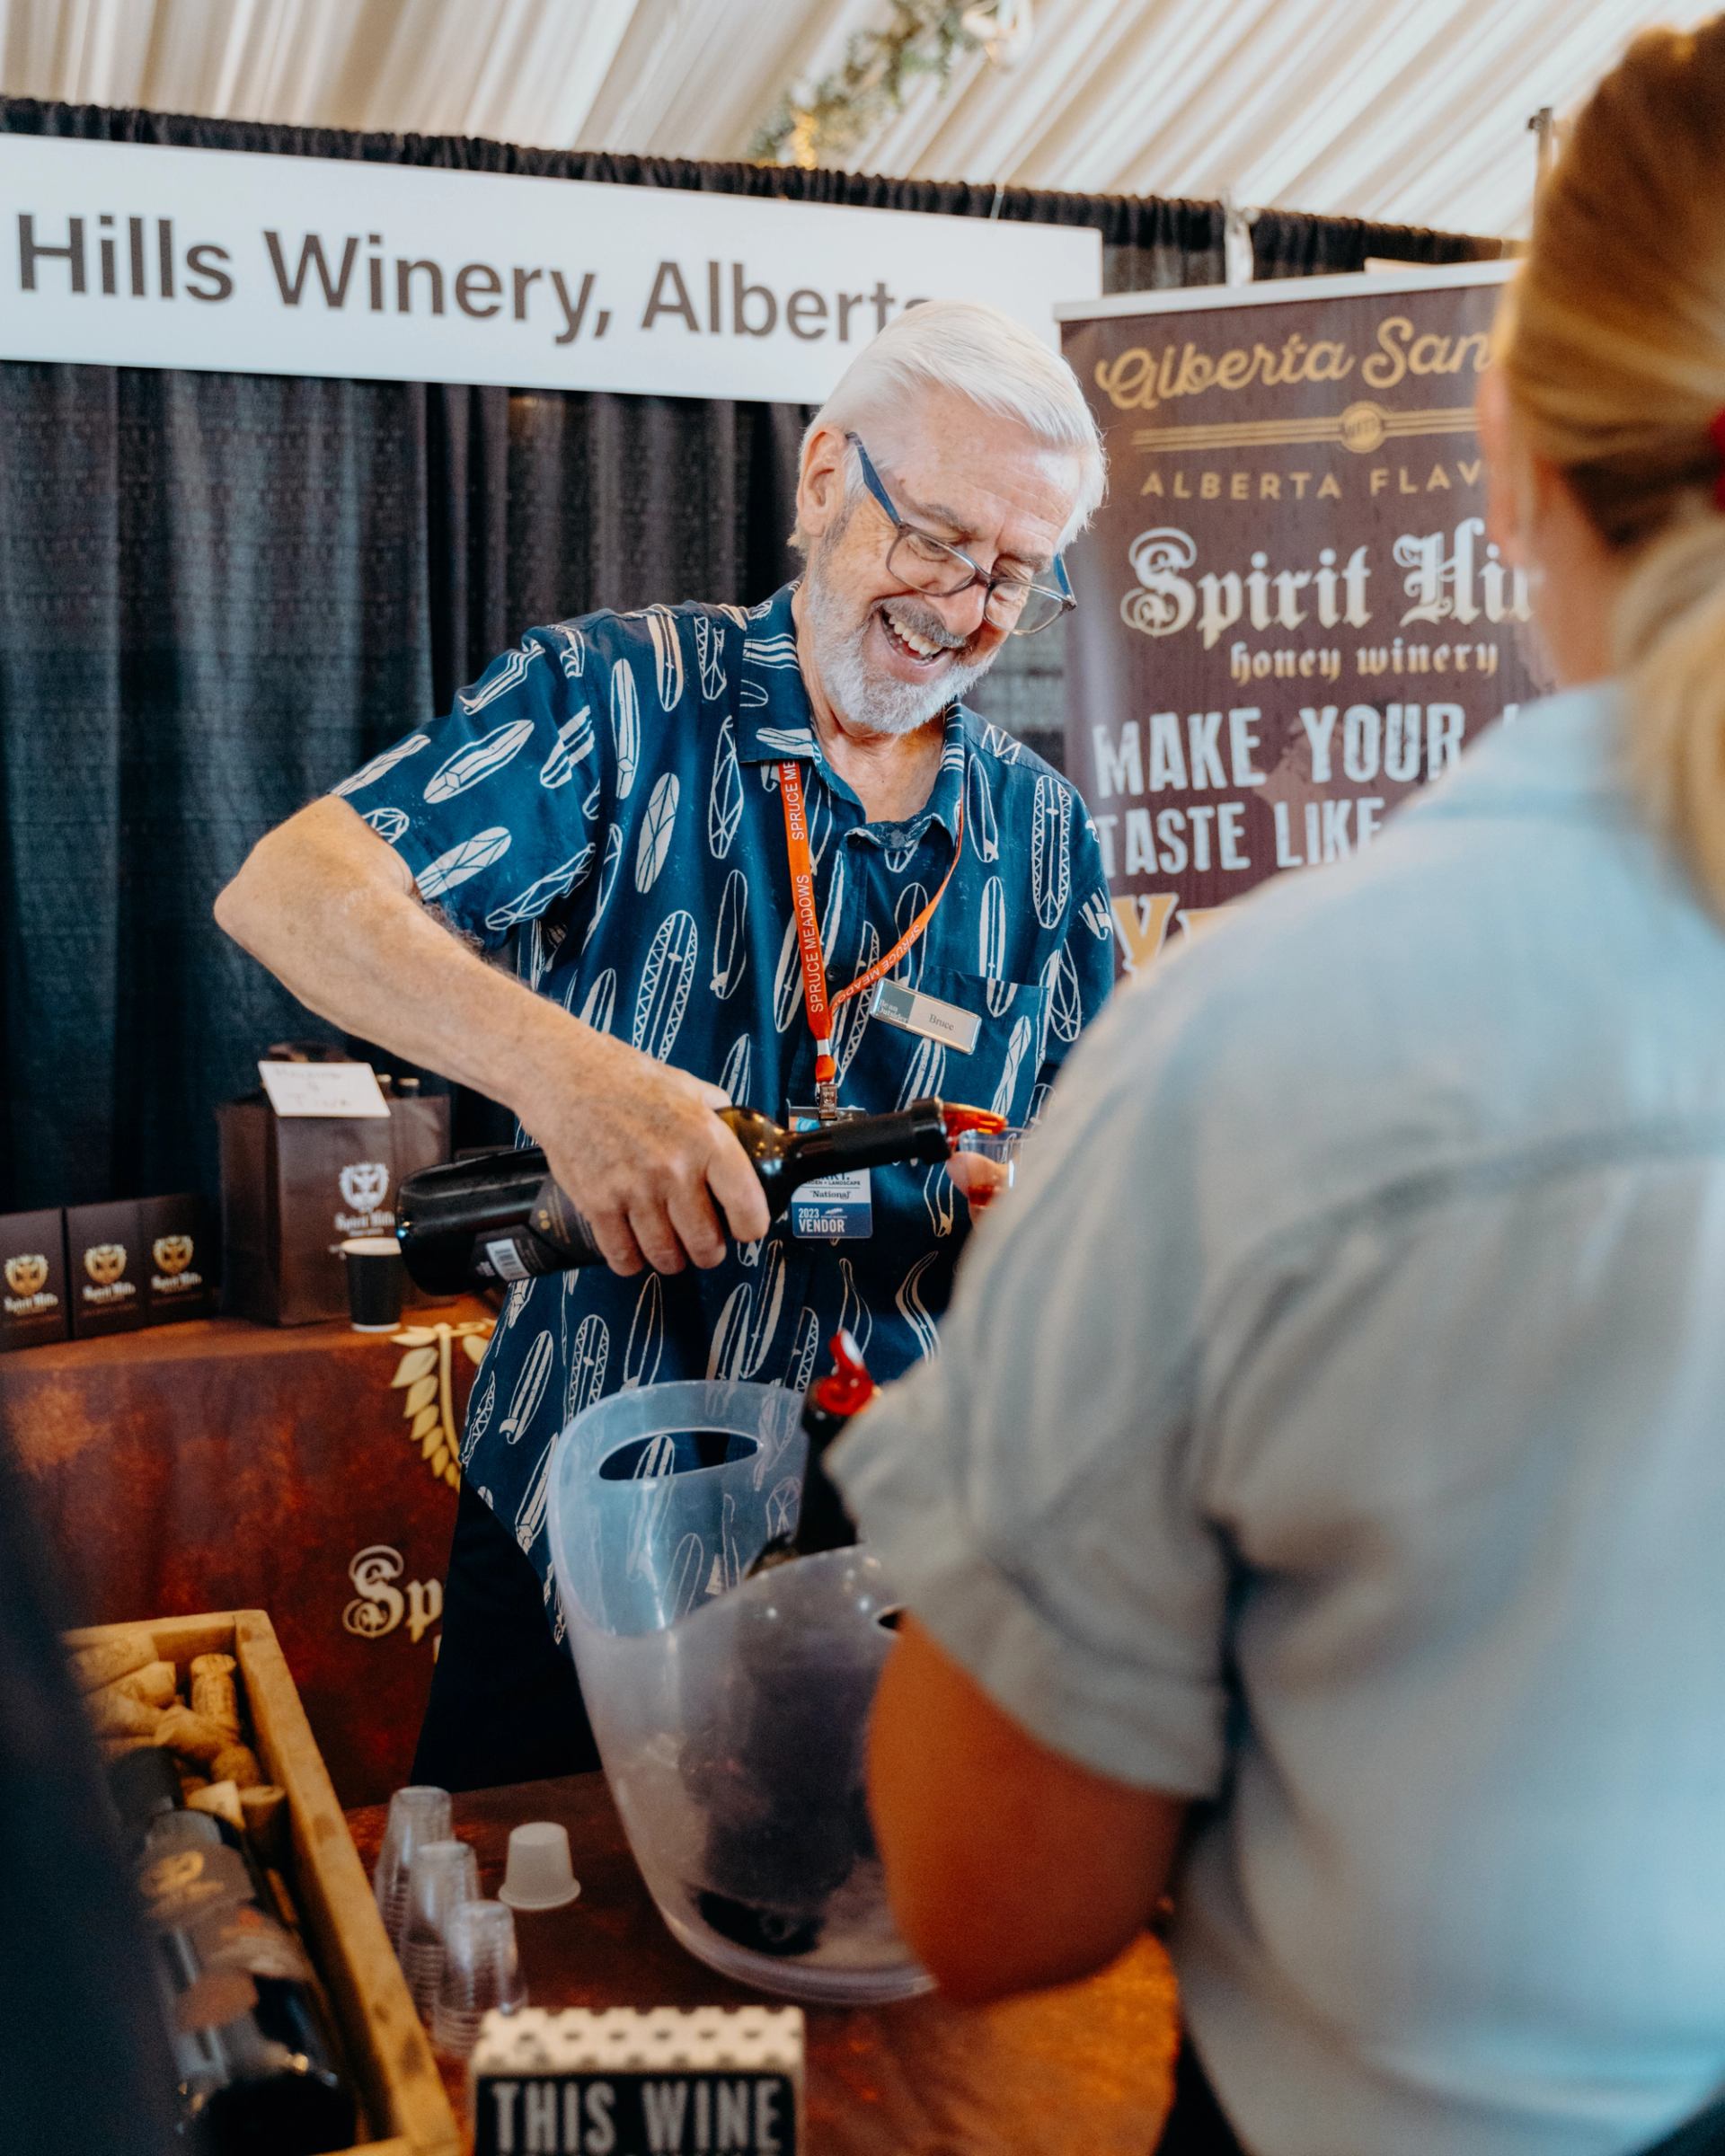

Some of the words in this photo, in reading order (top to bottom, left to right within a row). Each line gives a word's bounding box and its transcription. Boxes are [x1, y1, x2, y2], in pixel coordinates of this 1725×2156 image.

[18, 214, 234, 303] Hills
[263, 230, 611, 346] Winery,
[641, 261, 934, 343] Albert
[1094, 331, 1355, 411] Alberta
[1141, 471, 1341, 500] ALBERTA
[1120, 527, 1372, 650] Spirit
[1230, 641, 1342, 686] honey
[1357, 637, 1499, 677] winery
[1092, 707, 1267, 799] MAKE
[1298, 702, 1465, 783] YOUR
[784, 782, 805, 840] SPRUCE
[1098, 801, 1252, 879] TASTE
[1274, 796, 1385, 870] LIKE
[796, 874, 818, 949] MEADOWS
[881, 924, 920, 968] SPRUCE
[806, 951, 824, 1012] SPRUCE
[928, 1013, 955, 1031] Bruce
[798, 1207, 820, 1219] 2023
[798, 1219, 845, 1233] VENDOR
[492, 2080, 616, 2154] THIS
[641, 2080, 783, 2155] WINE
